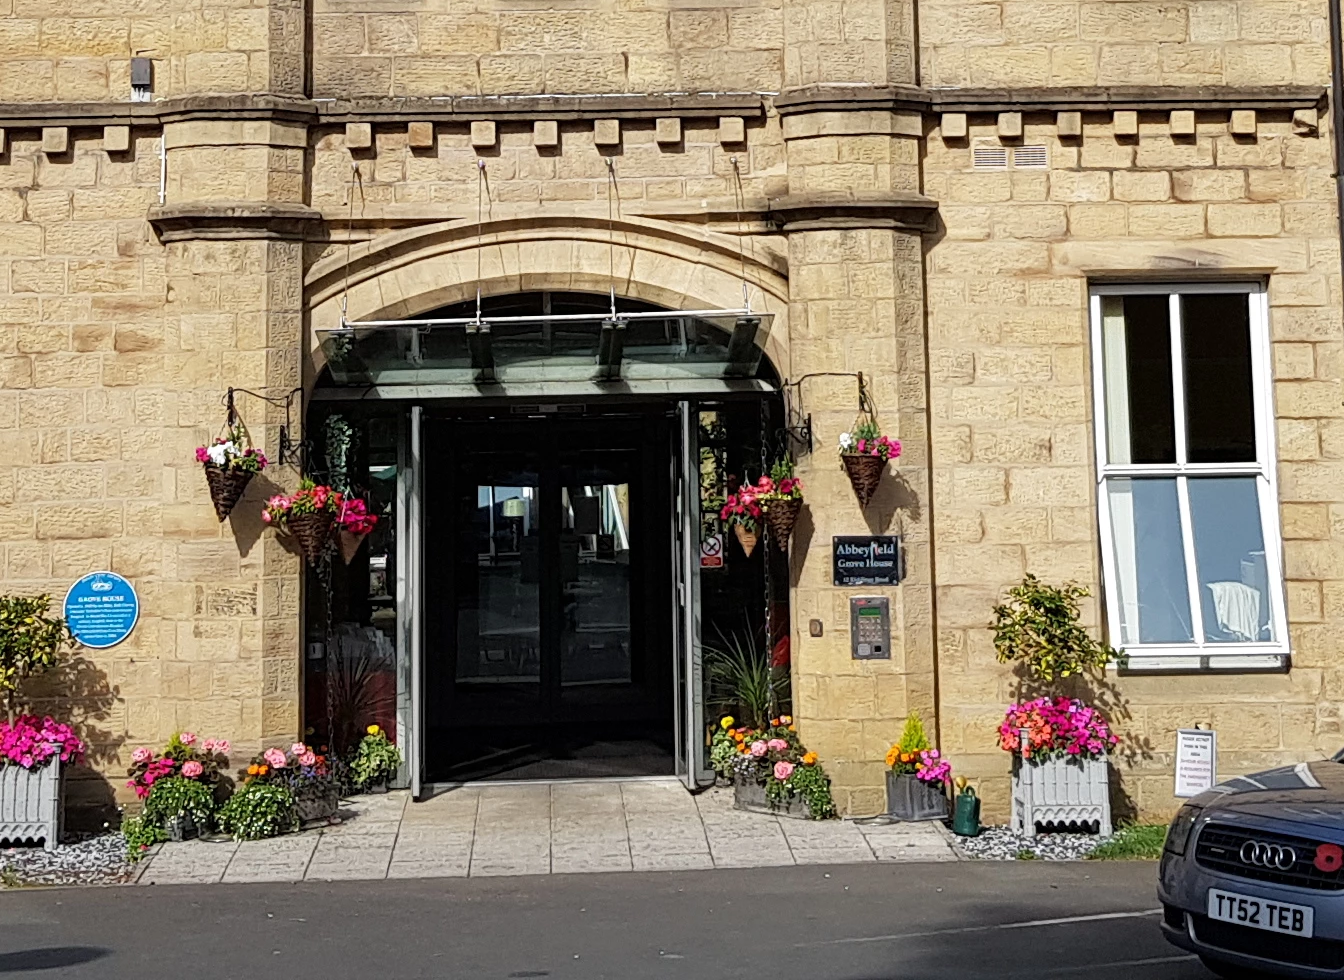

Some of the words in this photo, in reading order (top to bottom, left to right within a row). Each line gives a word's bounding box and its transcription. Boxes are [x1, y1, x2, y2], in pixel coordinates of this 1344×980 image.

[836, 541, 894, 559] Abbeyfield
[837, 559, 864, 568] Grove
[866, 559, 893, 568] House
[1216, 894, 1259, 924] TT52
[1266, 904, 1304, 932] TEB
